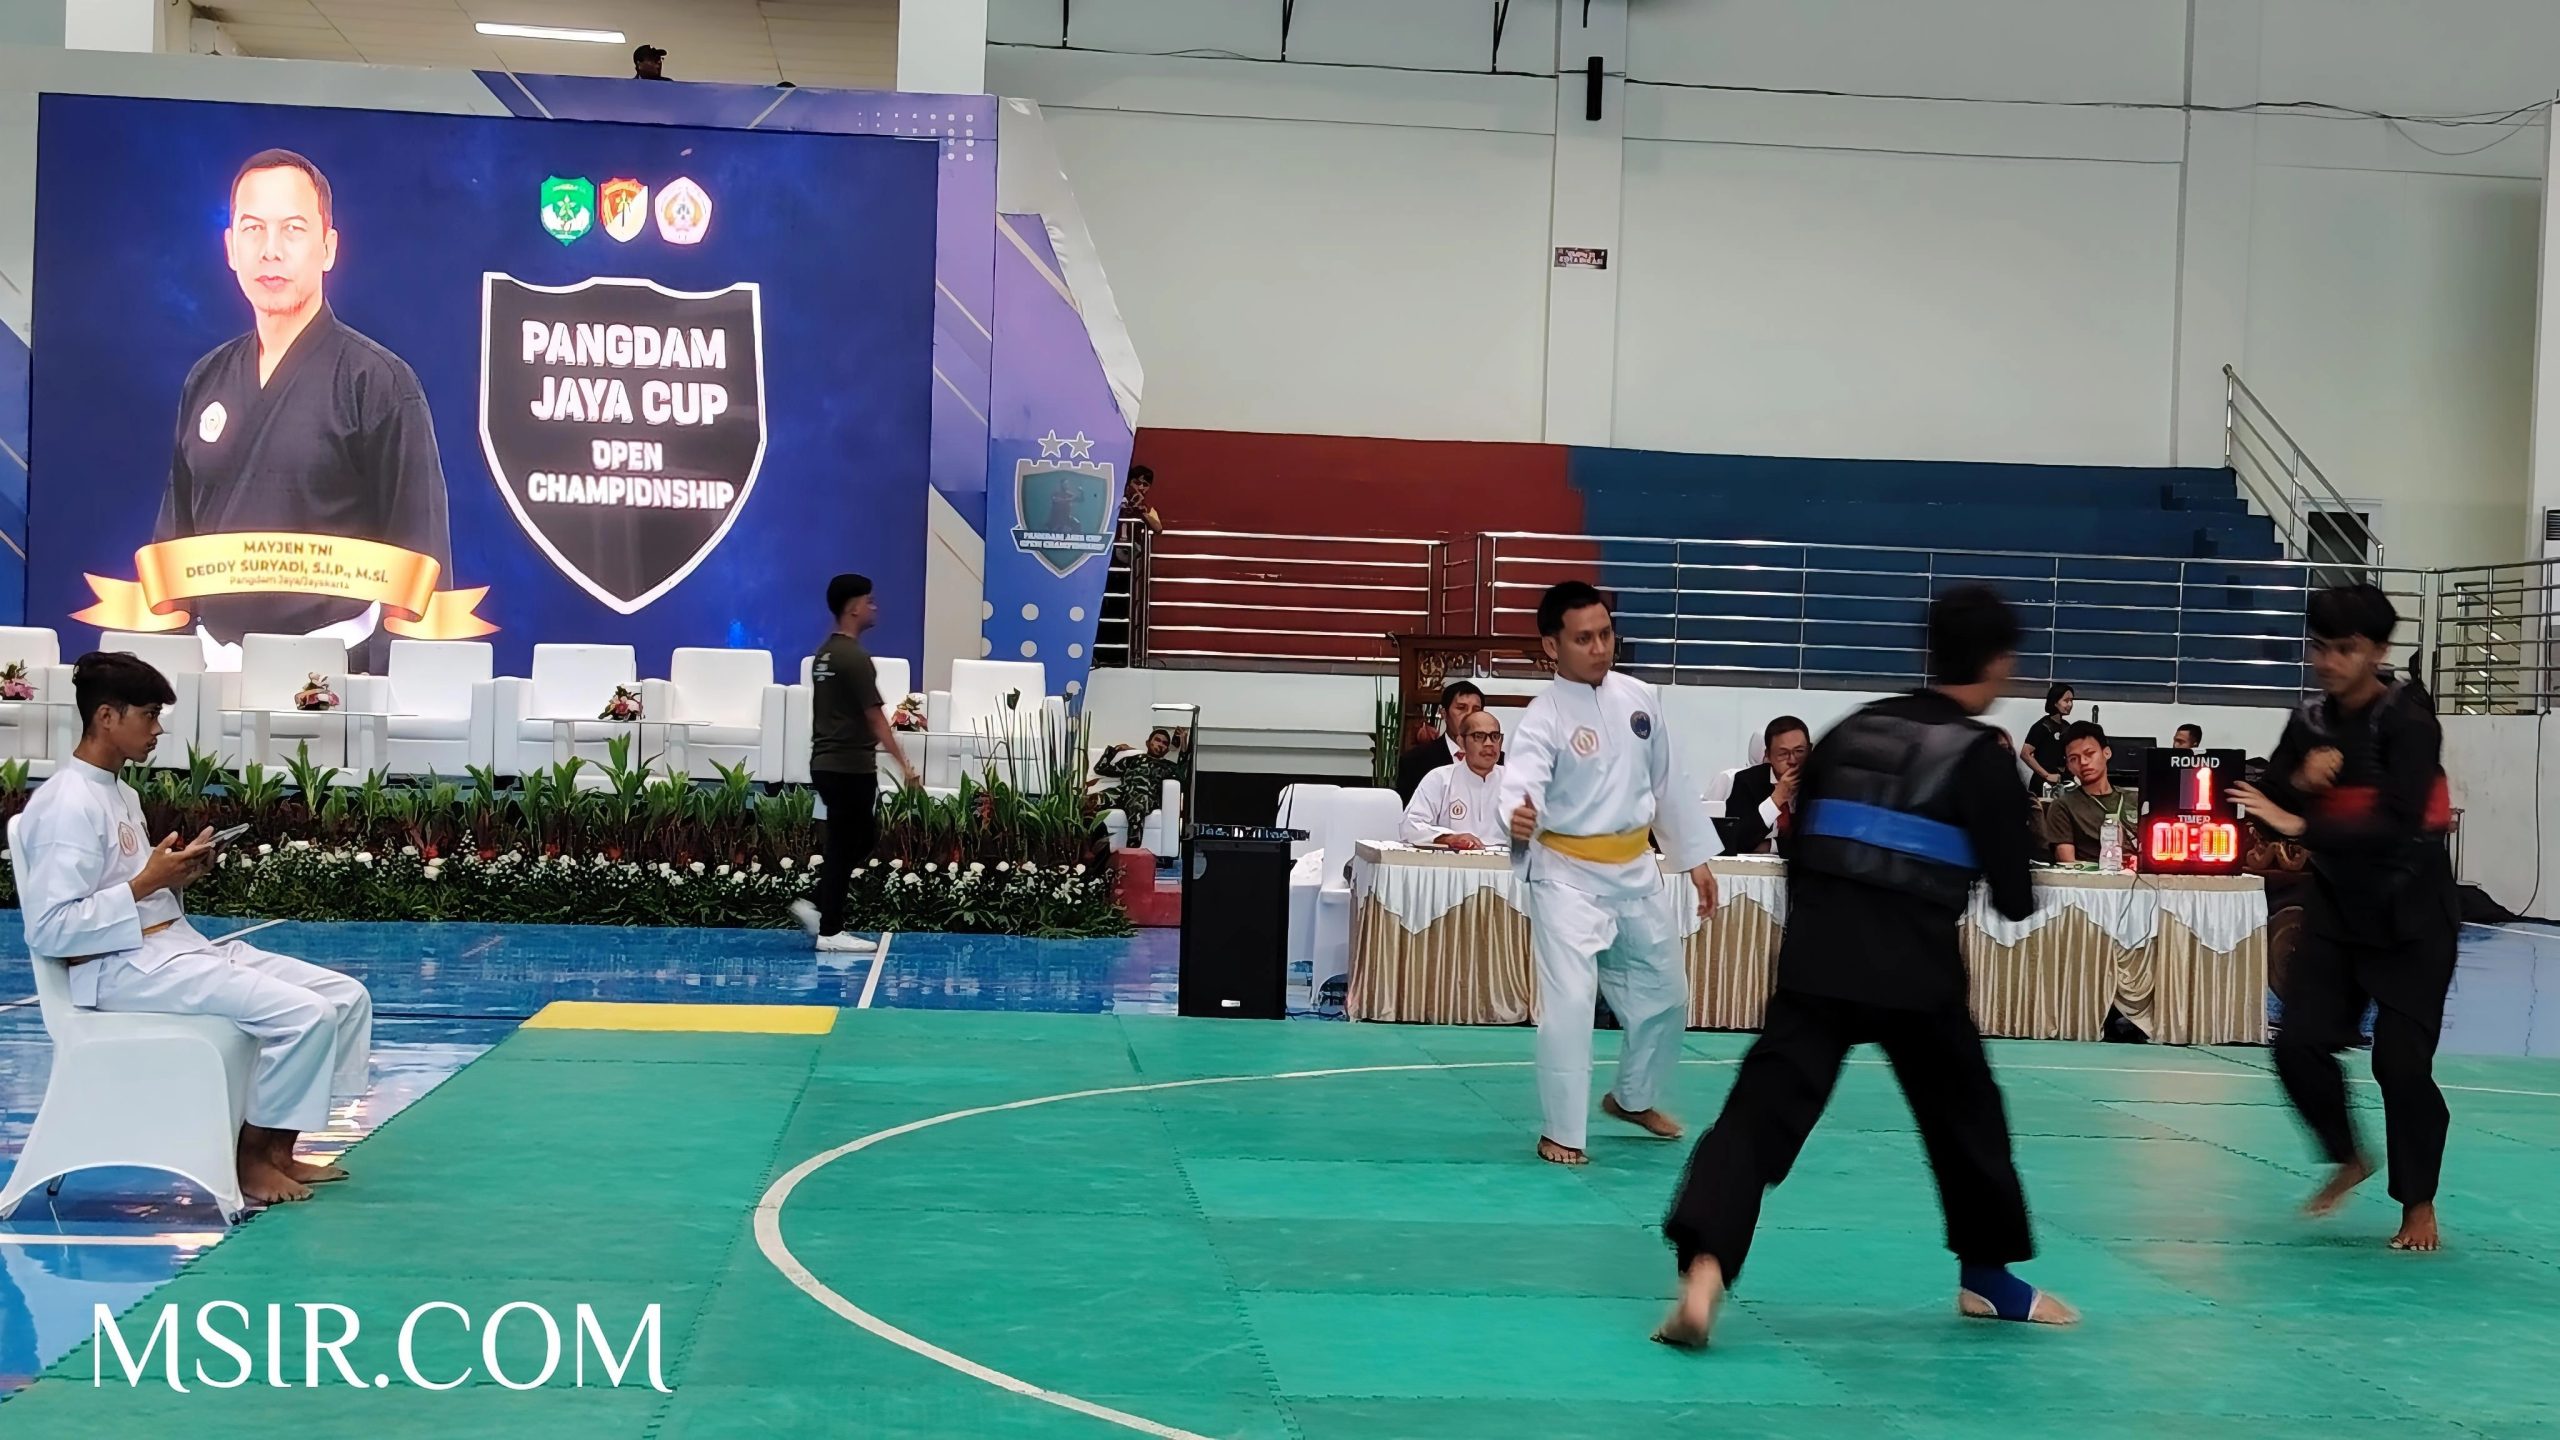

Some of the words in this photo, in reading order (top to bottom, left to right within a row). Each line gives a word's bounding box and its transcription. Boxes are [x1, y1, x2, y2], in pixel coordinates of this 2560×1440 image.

[522, 320, 727, 369] PANGDAM
[530, 376, 634, 424] JAYA
[641, 380, 728, 425] CUP
[591, 439, 663, 472] OPEN
[527, 472, 735, 510] CHAMPIONSHIP
[244, 541, 304, 554] MAYJEN
[309, 543, 333, 556] TNI
[186, 561, 235, 578] DEDDY
[2171, 756, 2220, 768] ROUND
[2195, 767, 2212, 811] 1
[2177, 815, 2211, 824] TIMER
[2152, 822, 2238, 862] 00:00
